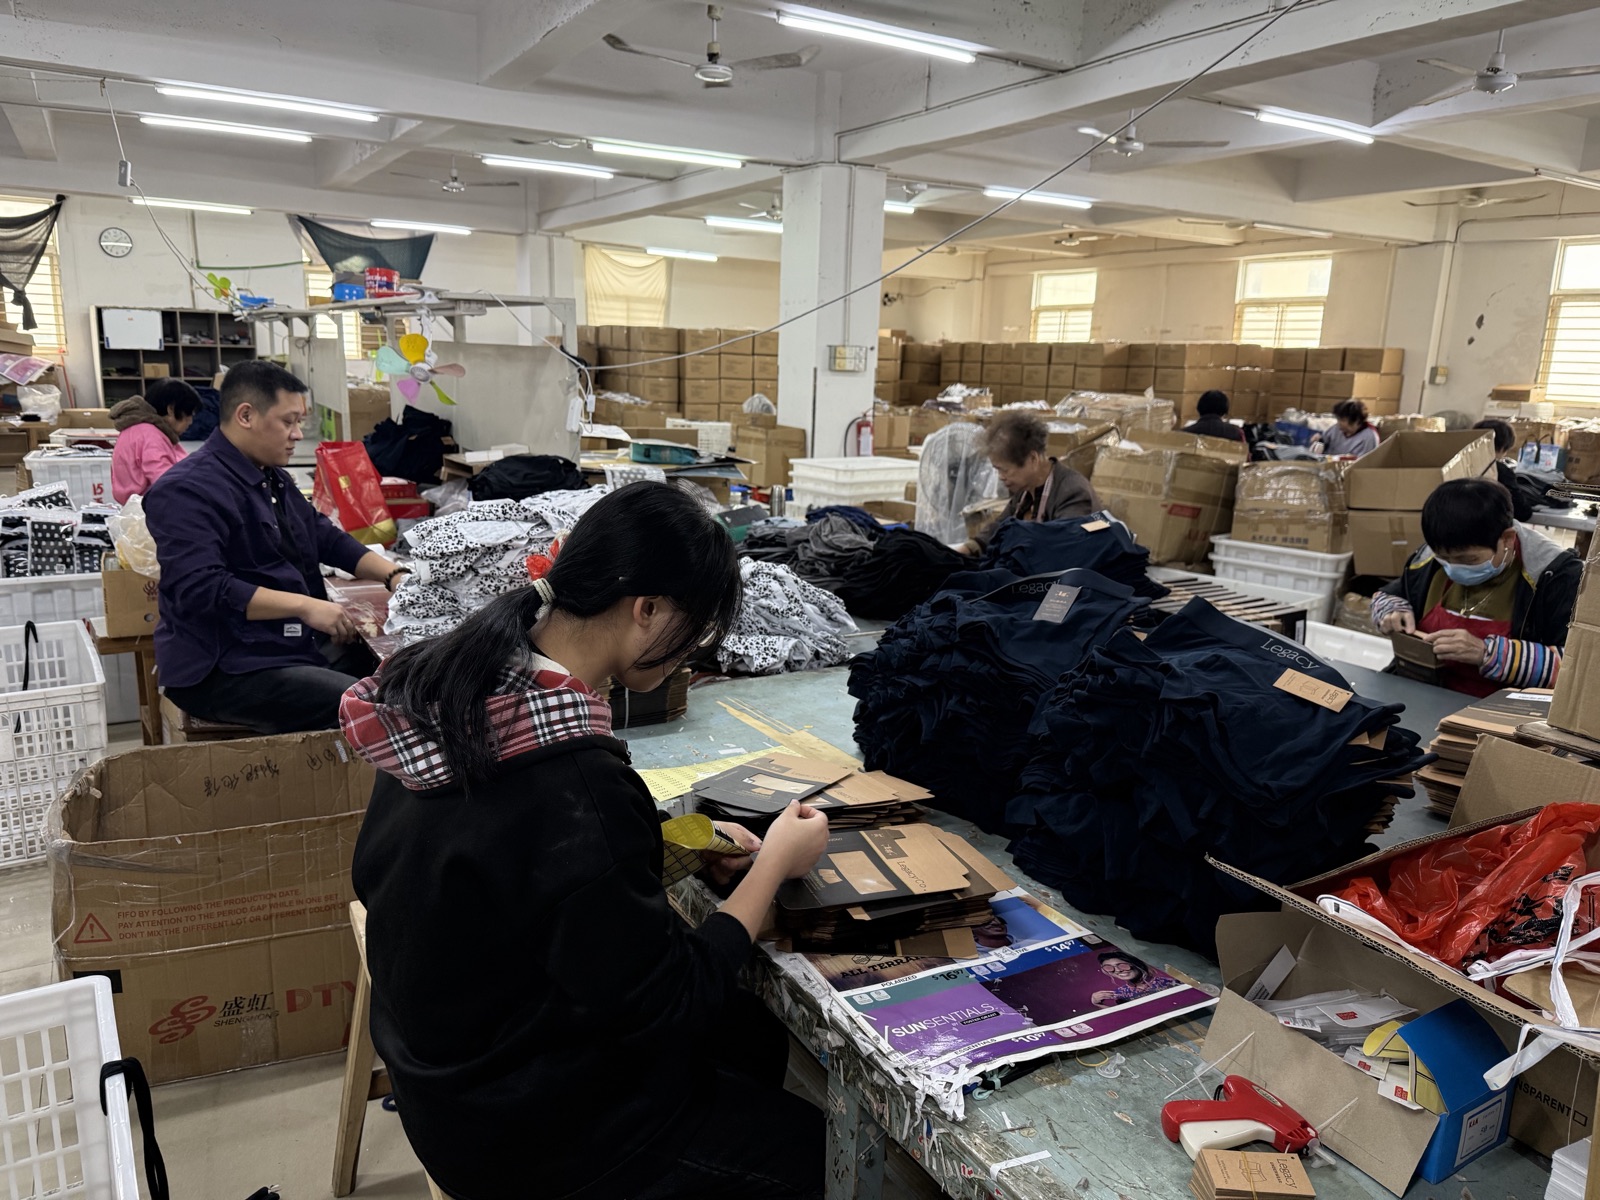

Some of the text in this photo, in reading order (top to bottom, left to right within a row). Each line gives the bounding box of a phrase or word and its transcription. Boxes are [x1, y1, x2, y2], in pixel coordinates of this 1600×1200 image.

[92, 483, 104, 496] 15
[1260, 638, 1320, 670] Legacy
[118, 910, 136, 919] FIFO
[152, 903, 202, 916] FOLLOWING
[206, 900, 220, 909] THE
[224, 892, 276, 907] PRODUCTION
[118, 921, 134, 929] PAY
[136, 916, 182, 928] ATTENTION
[199, 911, 214, 920] THE
[216, 906, 248, 917] PERIOD
[250, 903, 268, 912] GAP
[269, 900, 292, 910] WHILE
[295, 898, 304, 906] IN
[306, 896, 322, 904] ONE
[118, 930, 144, 940] DON'T
[146, 929, 162, 938] MIX
[164, 927, 180, 936] THE
[182, 920, 228, 934] DIFFERENT
[230, 917, 247, 926] LOT
[250, 915, 262, 923] OR
[308, 903, 336, 914] COLOR
[840, 956, 926, 978] ALL TERRA
[880, 974, 918, 988] POLARIZED
[218, 991, 274, 1018] 盛虹
[214, 1010, 280, 1028] SHENGHONG
[954, 1038, 997, 1056] ESSENTIALS
[1516, 1081, 1572, 1117] NSPARENT
[1276, 1158, 1298, 1189] Legacy
